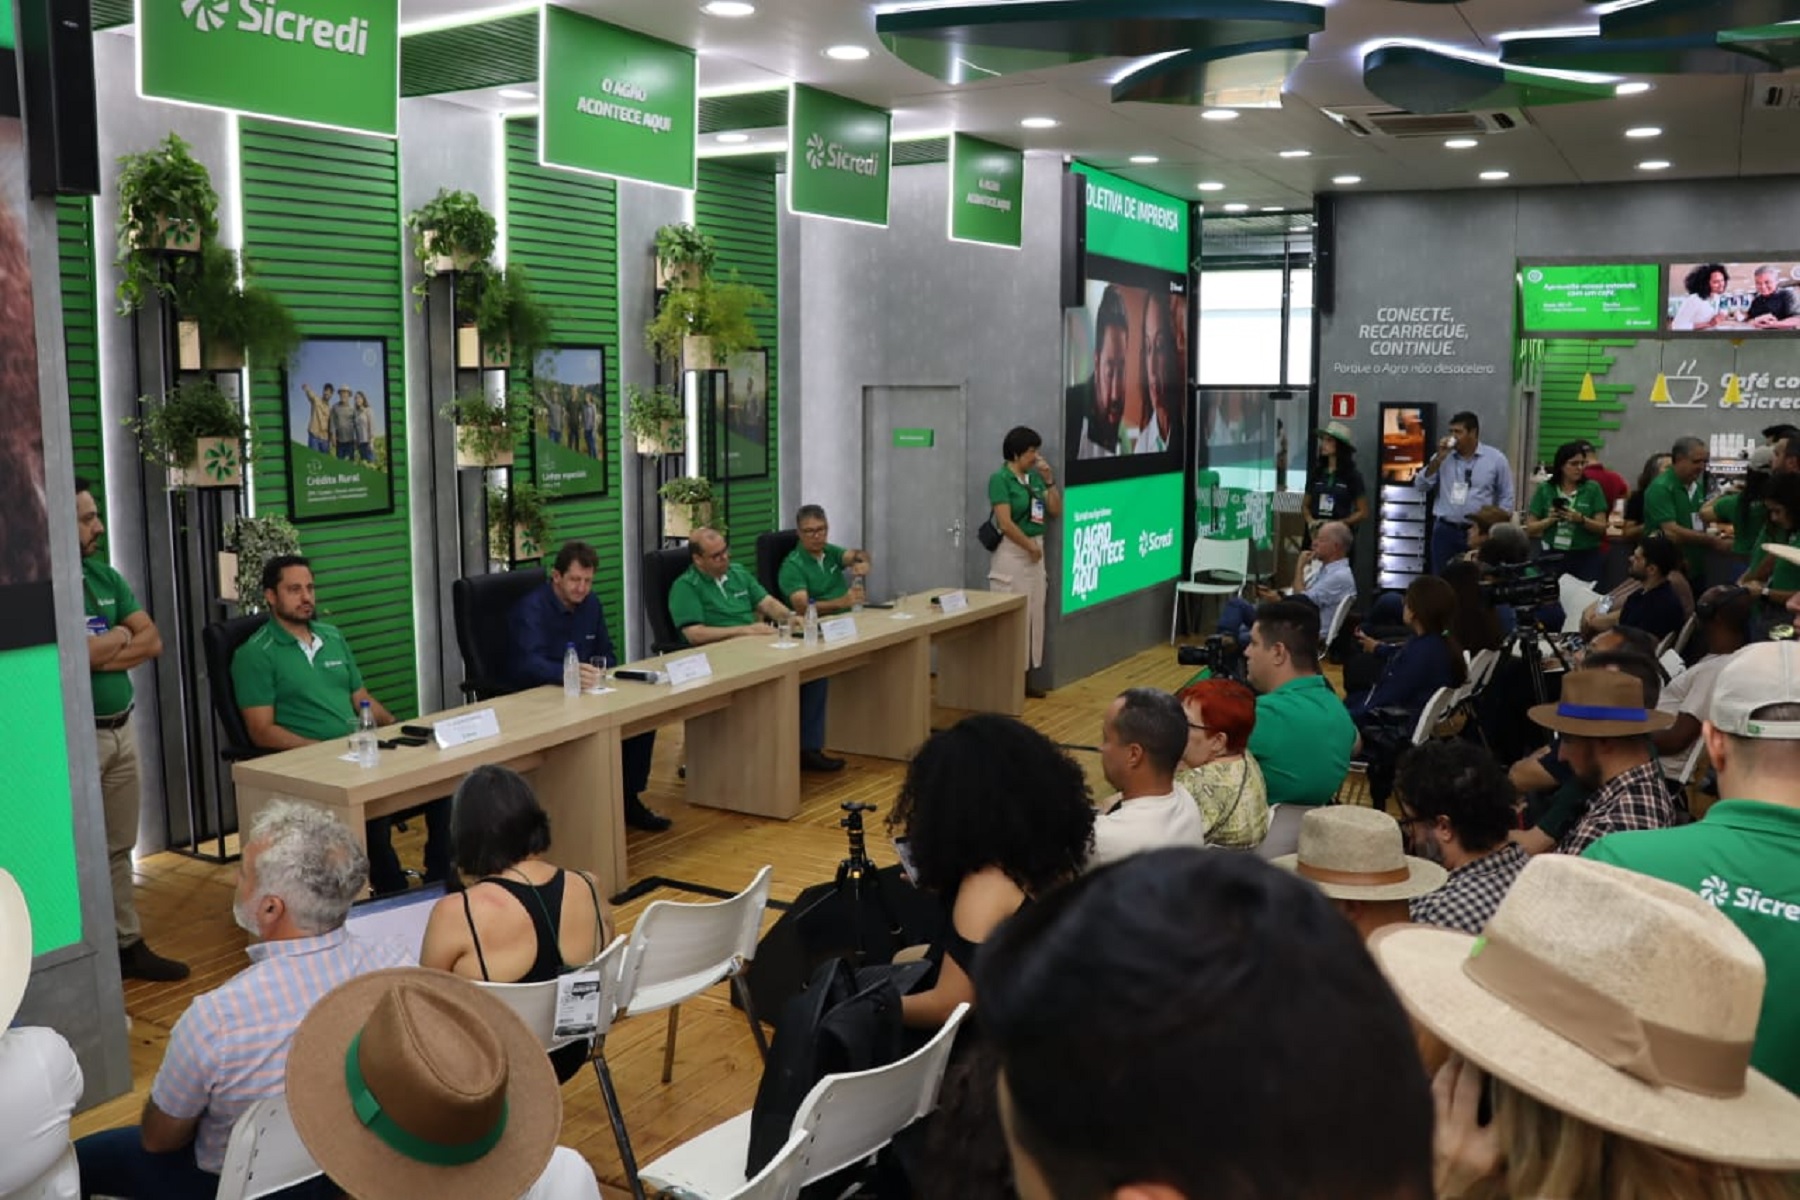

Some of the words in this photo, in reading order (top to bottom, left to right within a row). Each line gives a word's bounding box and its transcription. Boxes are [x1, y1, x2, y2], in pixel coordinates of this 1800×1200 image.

[237, 0, 369, 56] Sicredi
[602, 78, 612, 93] O
[613, 80, 647, 102] AGRO
[577, 96, 642, 125] ACONTECE
[642, 112, 672, 134] AQUI
[826, 142, 879, 177] Sicredi
[1086, 183, 1122, 215] OLETIVA
[1124, 196, 1136, 219] DE
[1137, 200, 1179, 233] IMPRENSA
[1377, 307, 1454, 323] CONECTE,
[1359, 324, 1469, 340] RECARREGUE,
[1370, 340, 1456, 356] CONTINUE.
[1334, 362, 1371, 374] Porque
[1382, 363, 1408, 375] Agro
[1083, 521, 1111, 549] AGRO
[1148, 528, 1173, 551] Sicredi
[1072, 539, 1125, 574] ACONTECE
[1072, 567, 1098, 601] AQUI
[1732, 886, 1800, 921] Sicre
